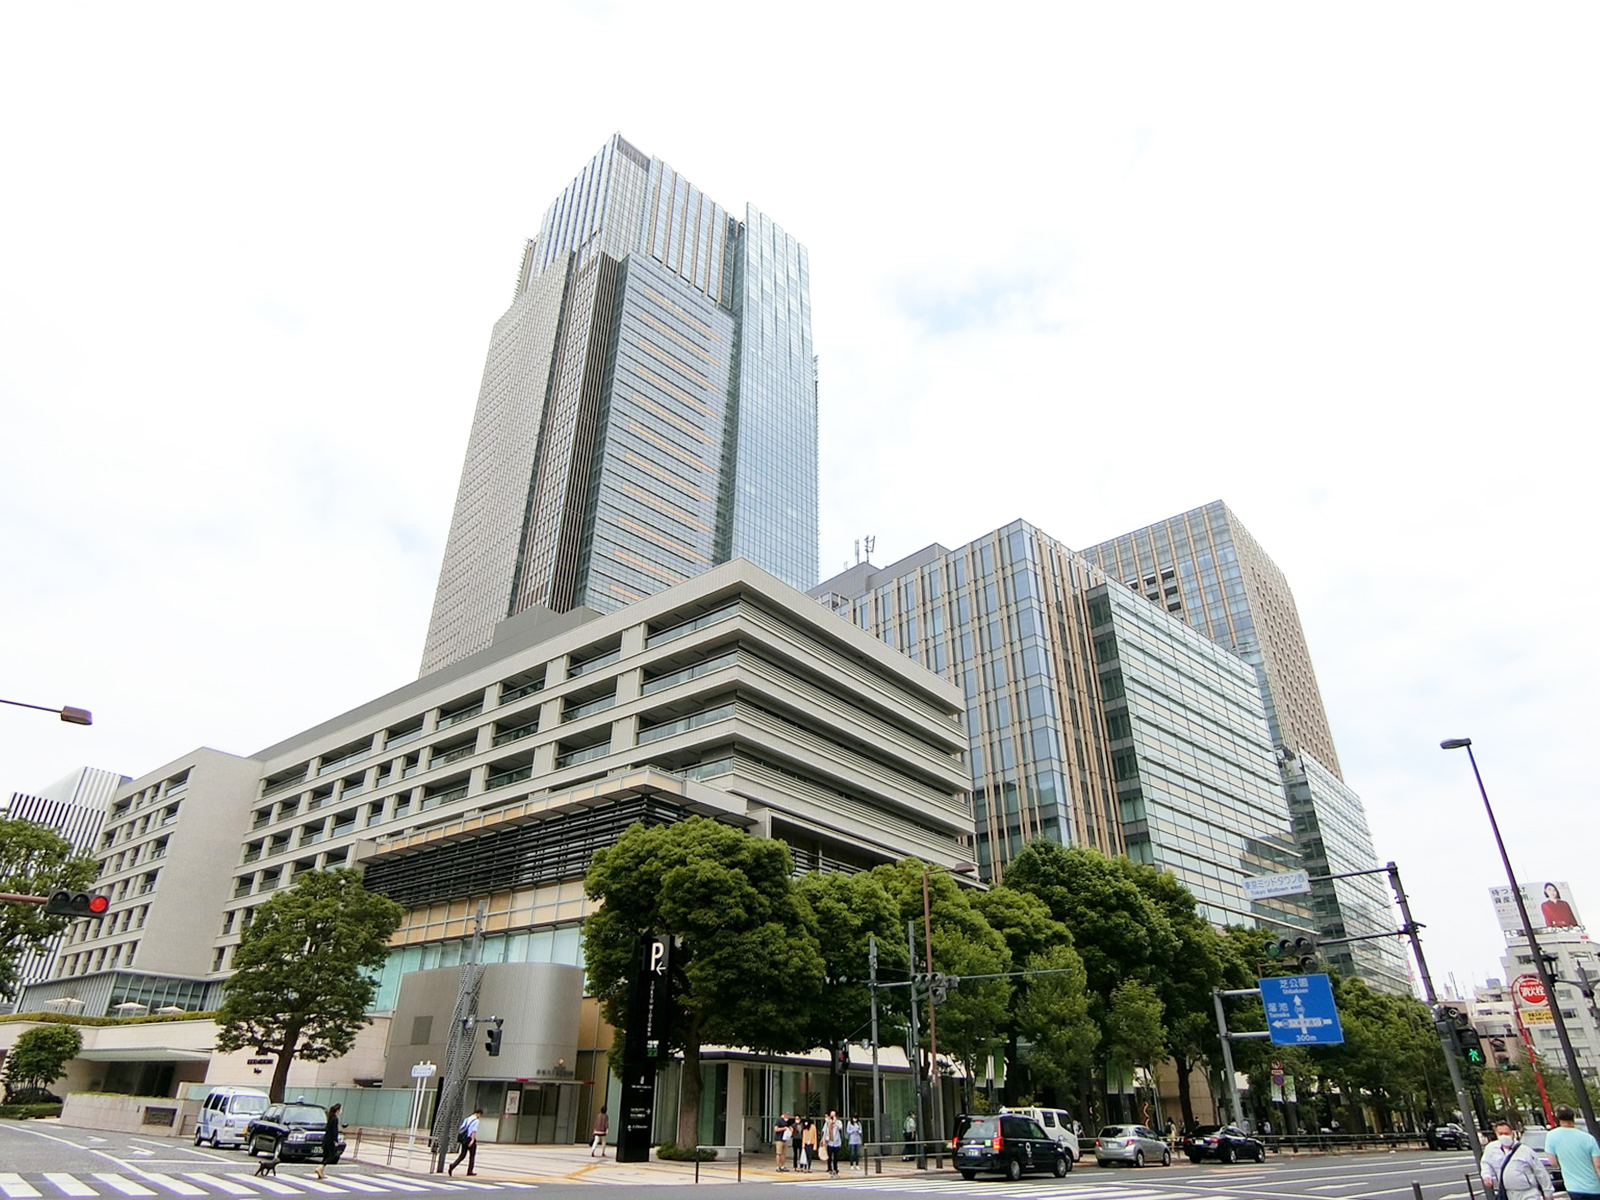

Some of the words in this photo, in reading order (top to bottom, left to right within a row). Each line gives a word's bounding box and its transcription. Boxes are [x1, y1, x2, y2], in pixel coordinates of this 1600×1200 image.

[1244, 873, 1305, 890] 東京ミッドタウン西
[650, 942, 664, 971] P
[1279, 978, 1309, 989] 芝公園
[1520, 985, 1547, 997] 消火栓
